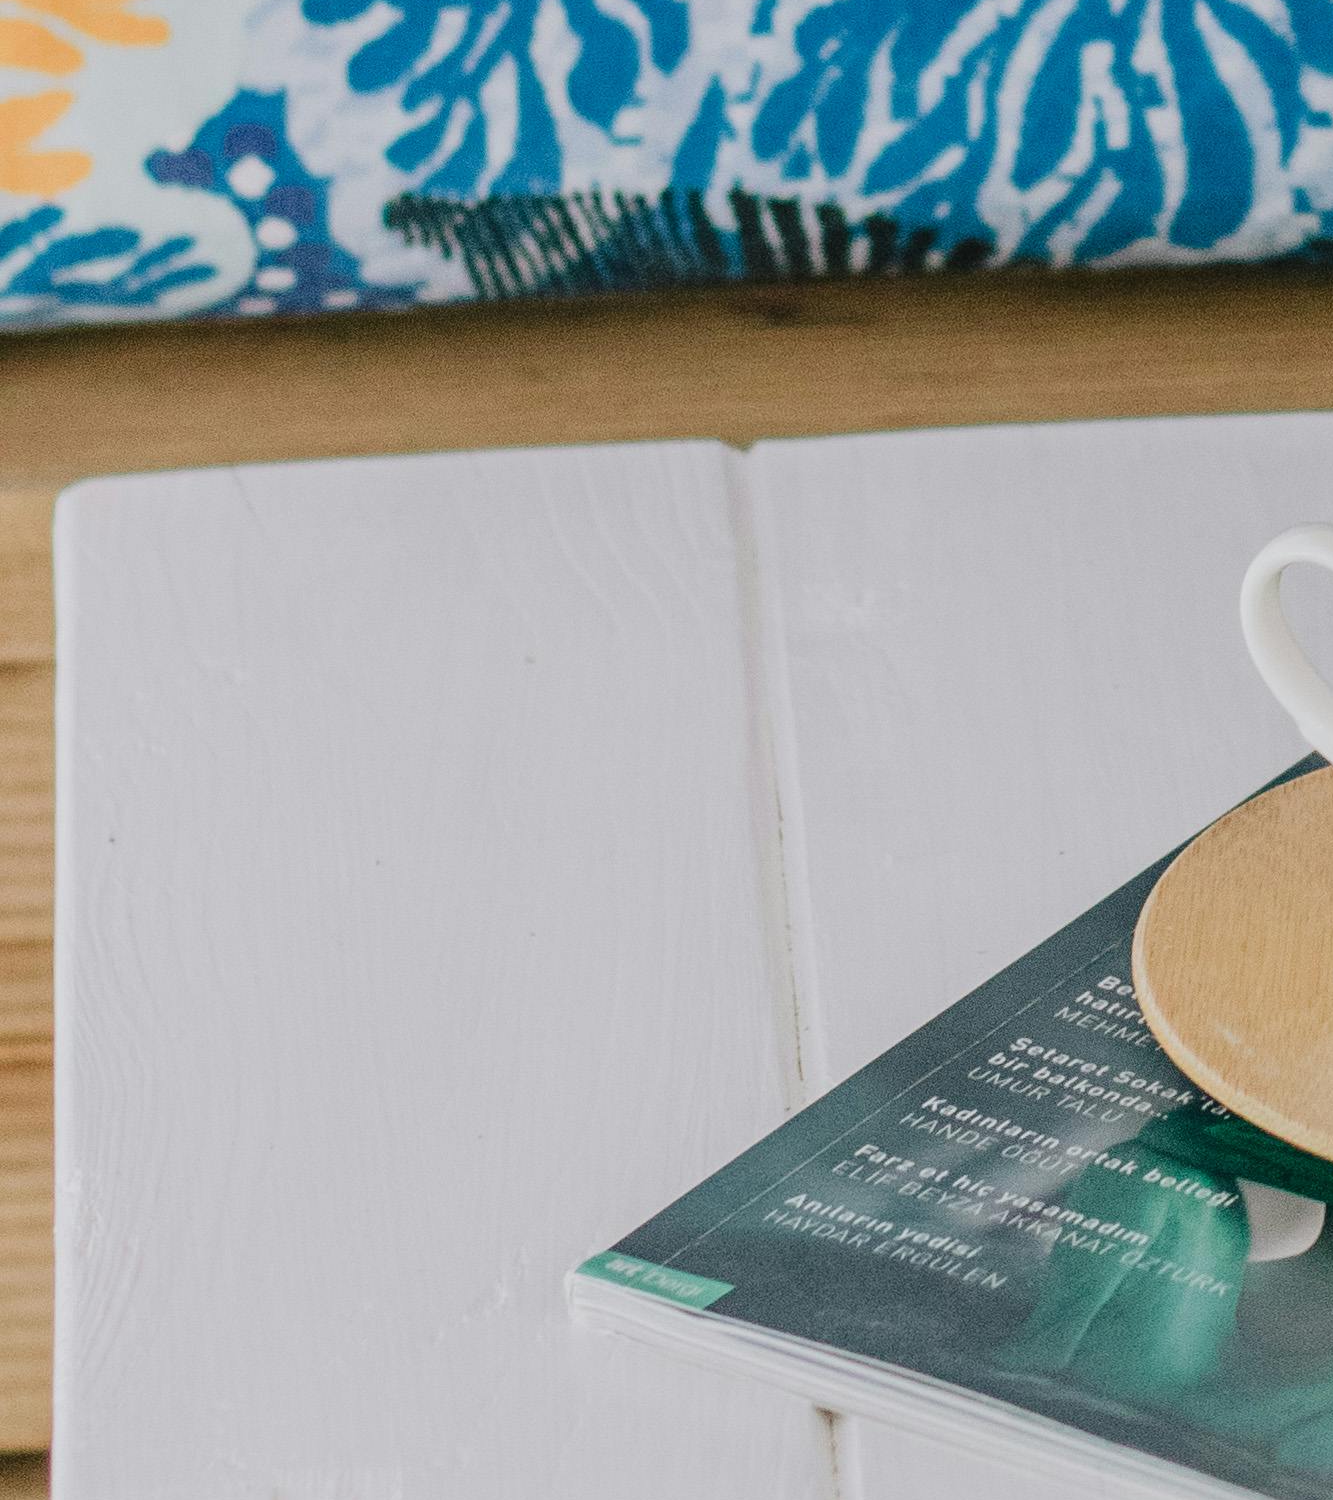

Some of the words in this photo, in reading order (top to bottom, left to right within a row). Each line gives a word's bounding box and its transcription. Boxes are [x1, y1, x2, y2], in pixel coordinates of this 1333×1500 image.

[1054, 1006, 1163, 1052] MEHME
[988, 1051, 1029, 1071] bir
[967, 1066, 1050, 1100] UMUR
[1056, 1093, 1124, 1124] TALU
[900, 1112, 999, 1151] HANDE
[921, 1095, 1060, 1150] Kadınların
[1065, 1145, 1138, 1176] ortak
[854, 1143, 915, 1172] Farz
[919, 1166, 950, 1183] et
[762, 1207, 871, 1248] HAYDAR
[784, 1192, 894, 1233] Anıların
[894, 1226, 983, 1260] yedisi
[898, 1180, 985, 1216] BEYZA
[989, 1208, 1118, 1256] AKKANAT
